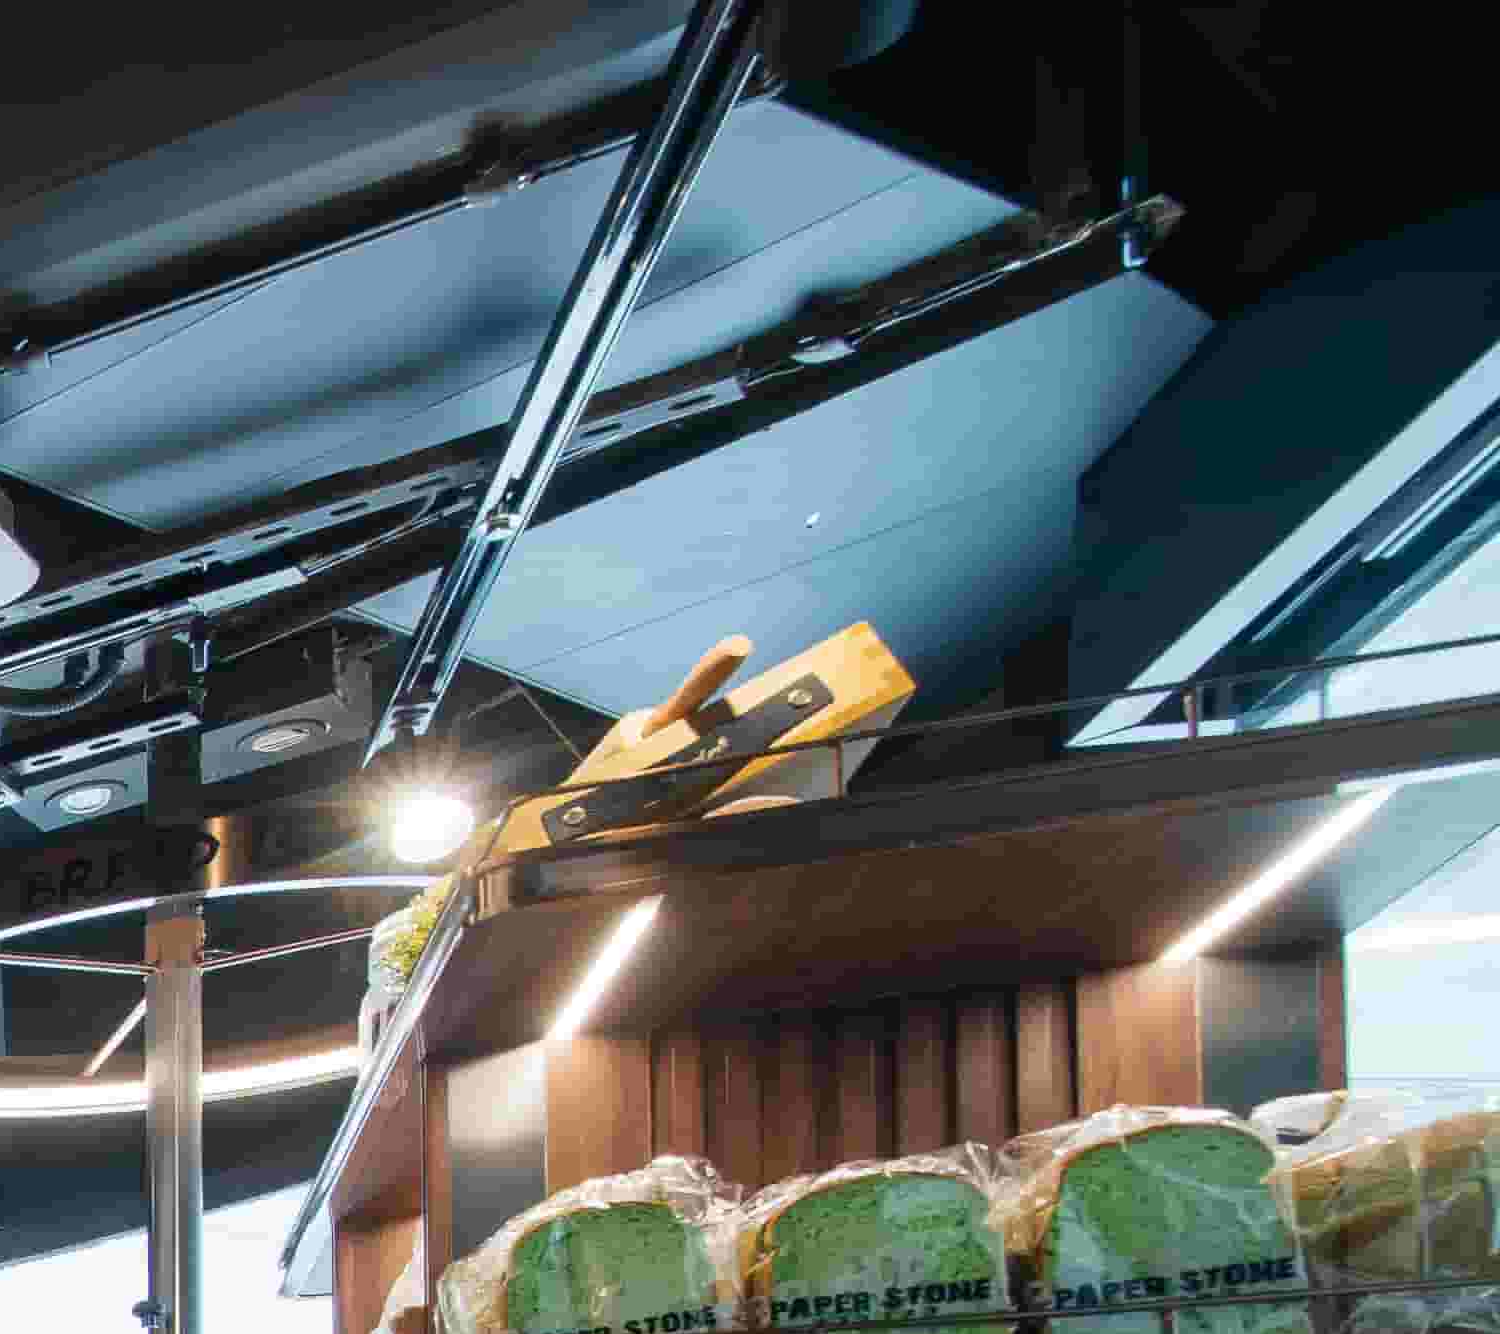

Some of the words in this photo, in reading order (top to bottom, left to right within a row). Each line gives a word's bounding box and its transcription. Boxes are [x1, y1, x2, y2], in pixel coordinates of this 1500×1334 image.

[771, 1291, 871, 1321] PAPER
[878, 1278, 992, 1309] STONE
[1054, 1275, 1170, 1311] PAPER
[1180, 1256, 1296, 1299] STONE
